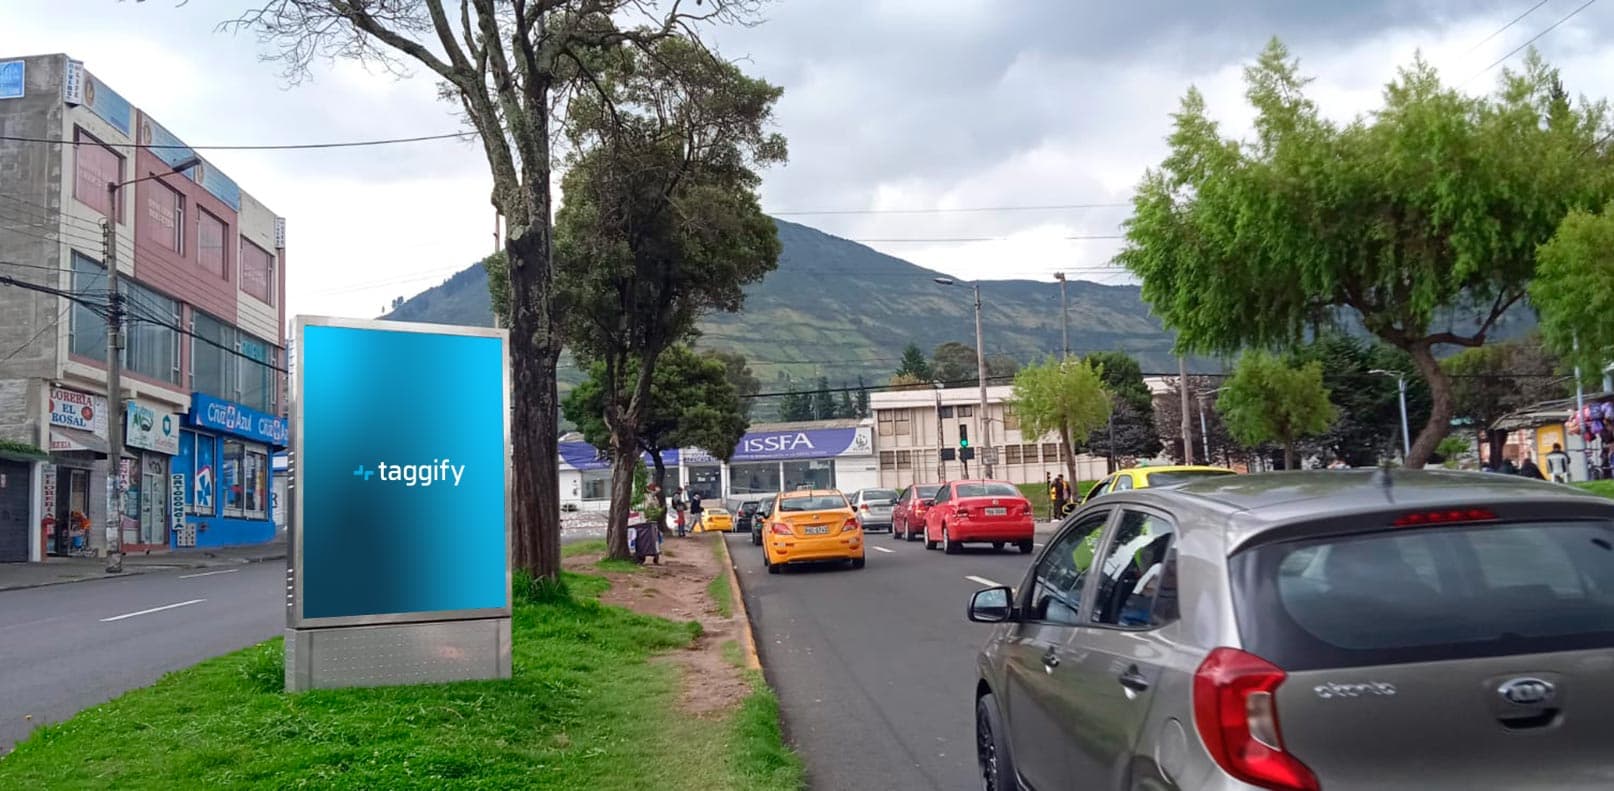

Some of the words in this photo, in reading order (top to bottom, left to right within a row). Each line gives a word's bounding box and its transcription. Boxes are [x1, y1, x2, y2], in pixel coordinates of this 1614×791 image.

[50, 390, 92, 407] LORERIA
[62, 403, 76, 415] EL
[208, 402, 226, 425] Cruz
[235, 411, 251, 432] Azul
[51, 412, 86, 427] ROSAL
[744, 433, 815, 453] ISSFA
[378, 459, 465, 486] taggify
[172, 474, 184, 529] ORTODONCIA
